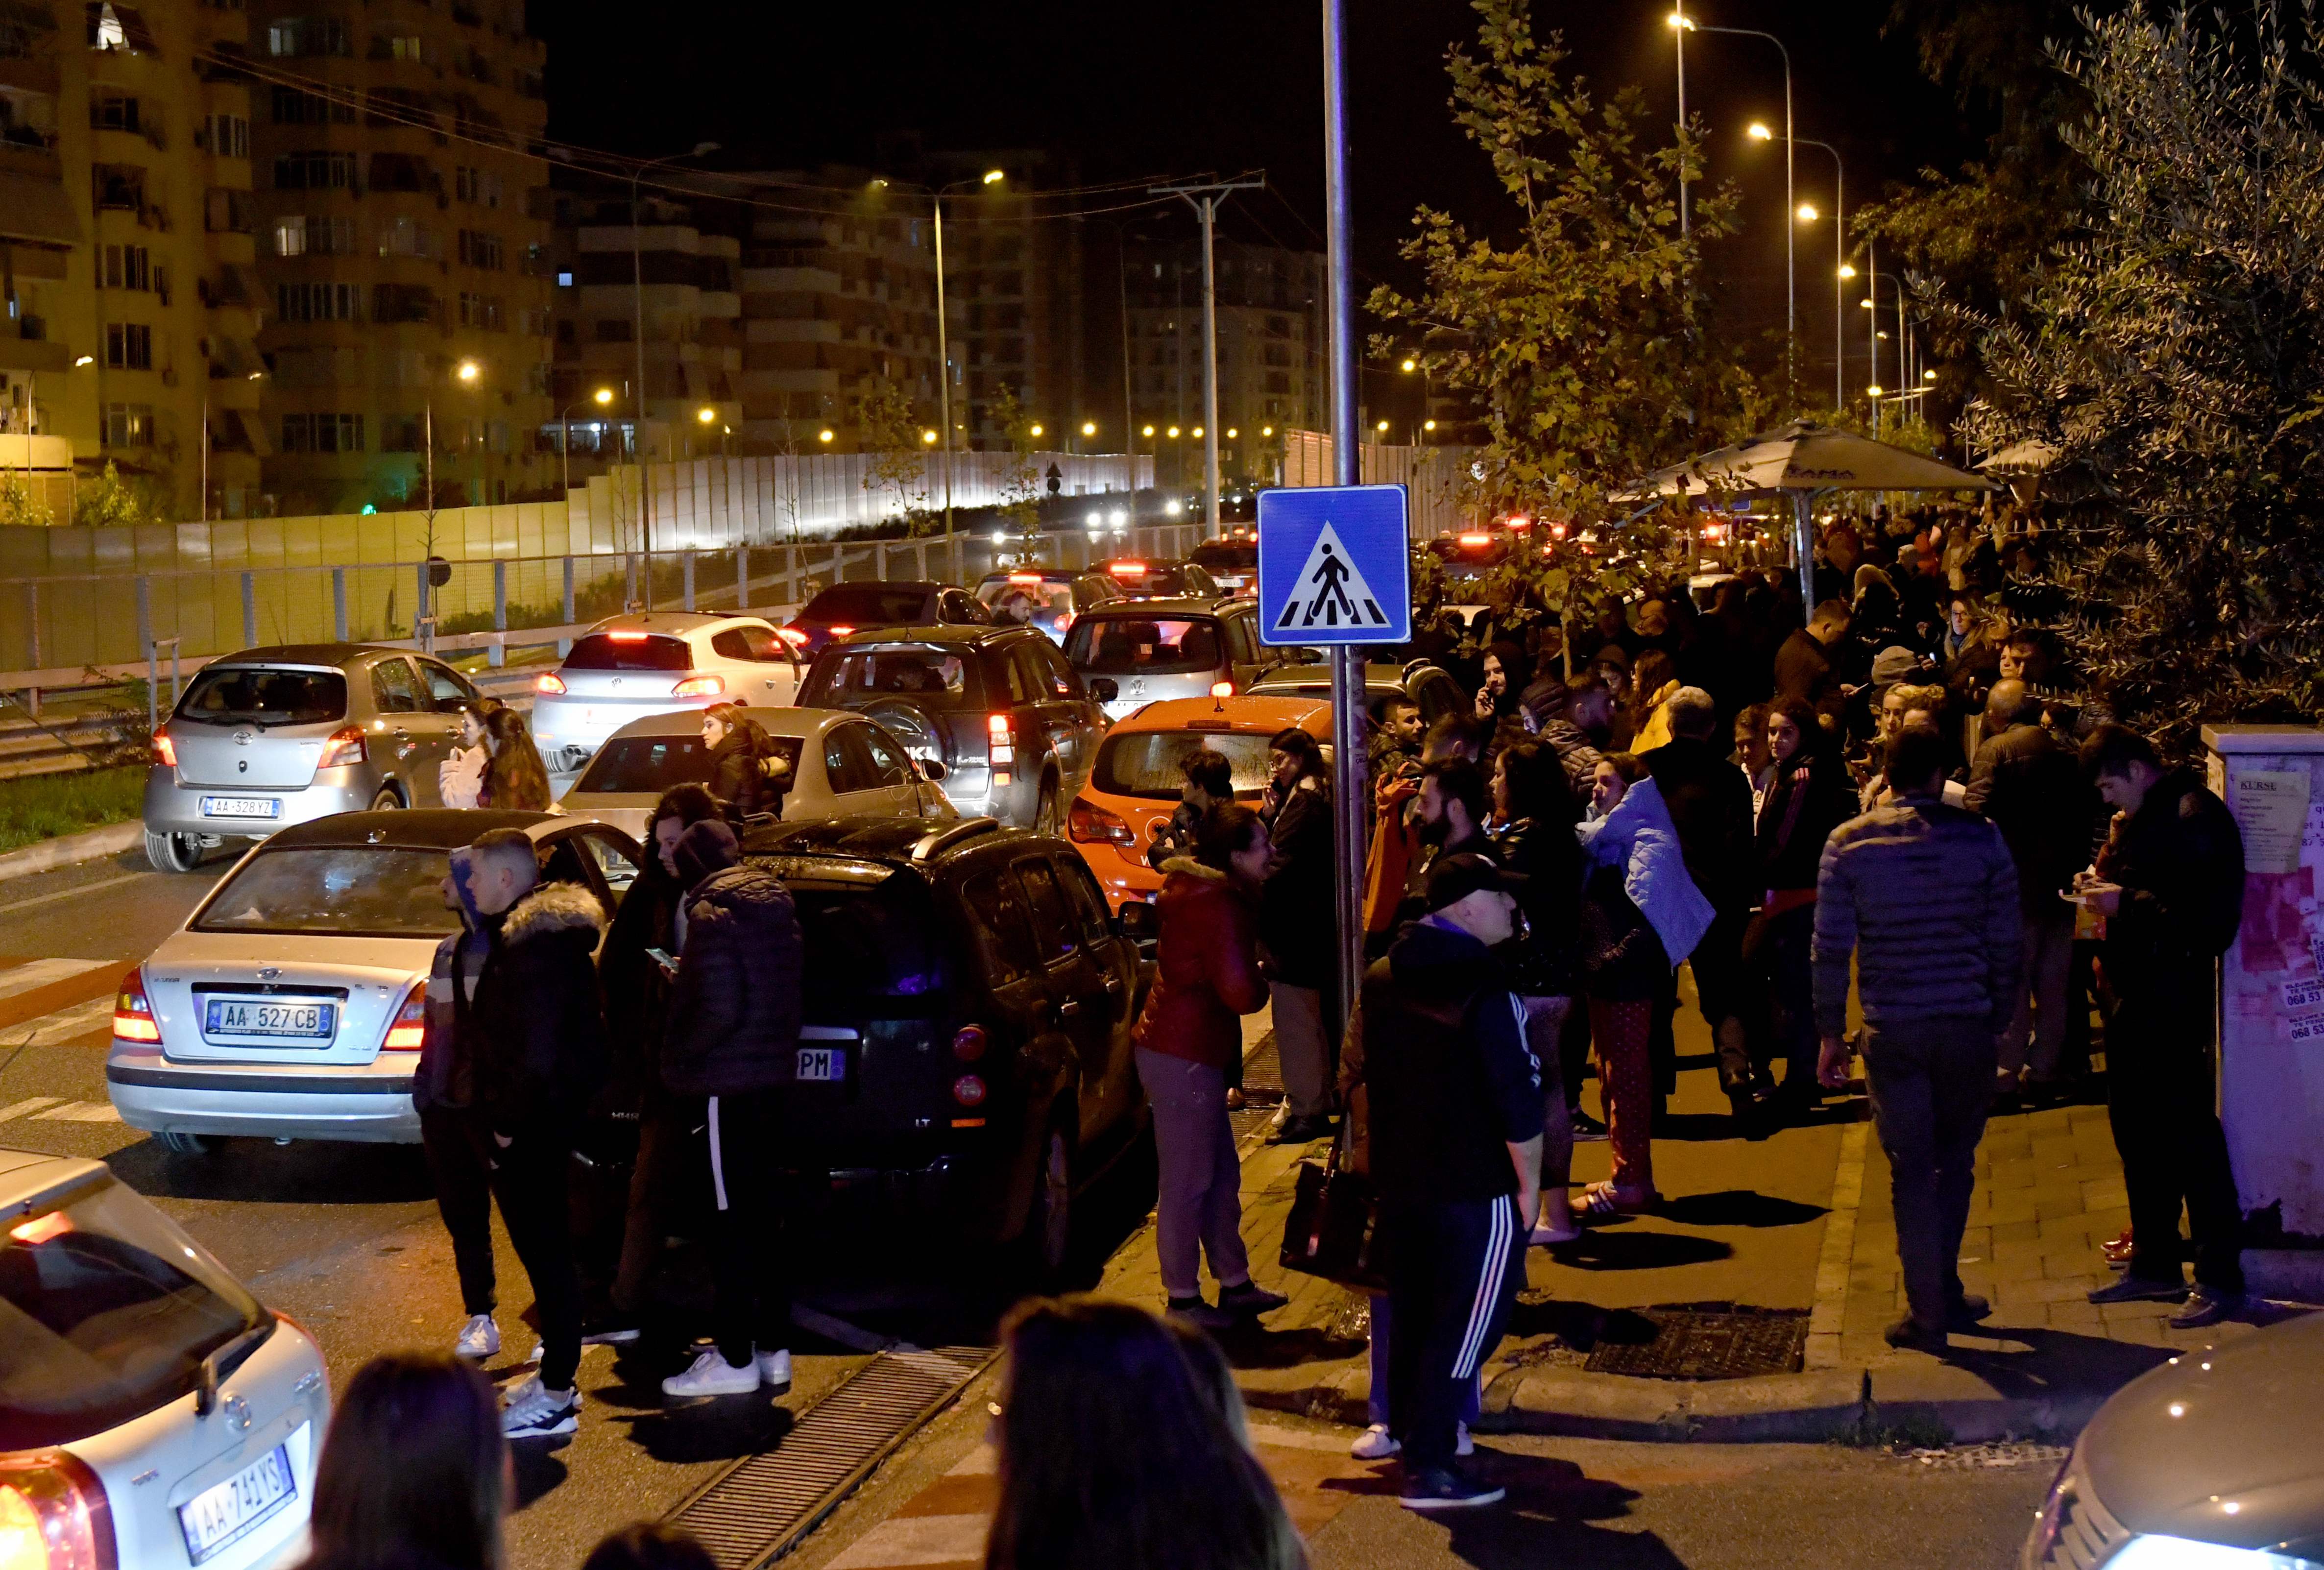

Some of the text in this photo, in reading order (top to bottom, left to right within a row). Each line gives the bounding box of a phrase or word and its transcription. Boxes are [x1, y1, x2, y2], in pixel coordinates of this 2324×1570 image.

[216, 800, 228, 812] AA
[235, 801, 255, 813] 328
[2288, 991, 2321, 1006] 068 53
[225, 1006, 317, 1029] AA 527 CB
[2292, 1027, 2310, 1039] 068
[800, 1053, 828, 1077] PM
